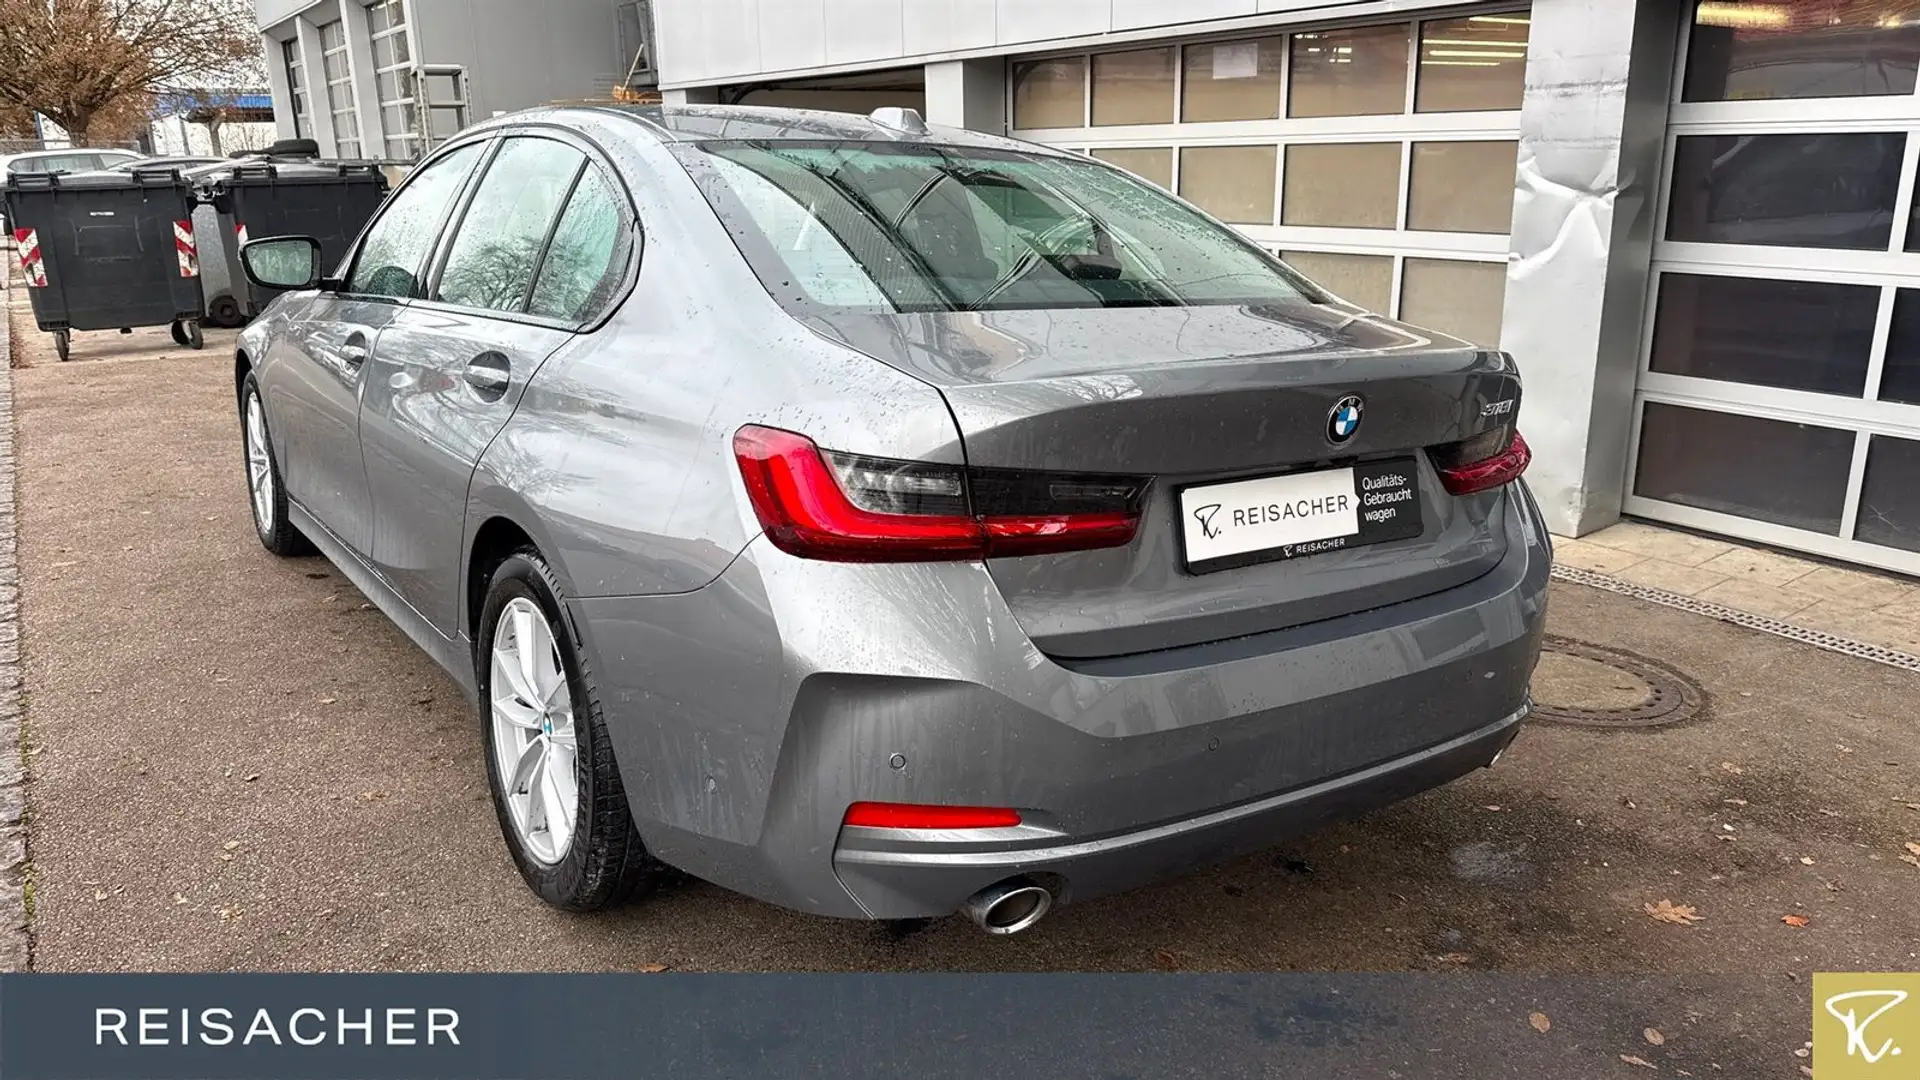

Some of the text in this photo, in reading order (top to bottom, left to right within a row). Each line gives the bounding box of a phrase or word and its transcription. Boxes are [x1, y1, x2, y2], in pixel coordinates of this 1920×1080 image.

[1362, 474, 1407, 490] Qualitäts-
[1363, 488, 1412, 506] Gebraucht
[1233, 494, 1349, 527] REISACHER
[1364, 507, 1396, 523] wagen
[1296, 538, 1346, 554] REISACHER
